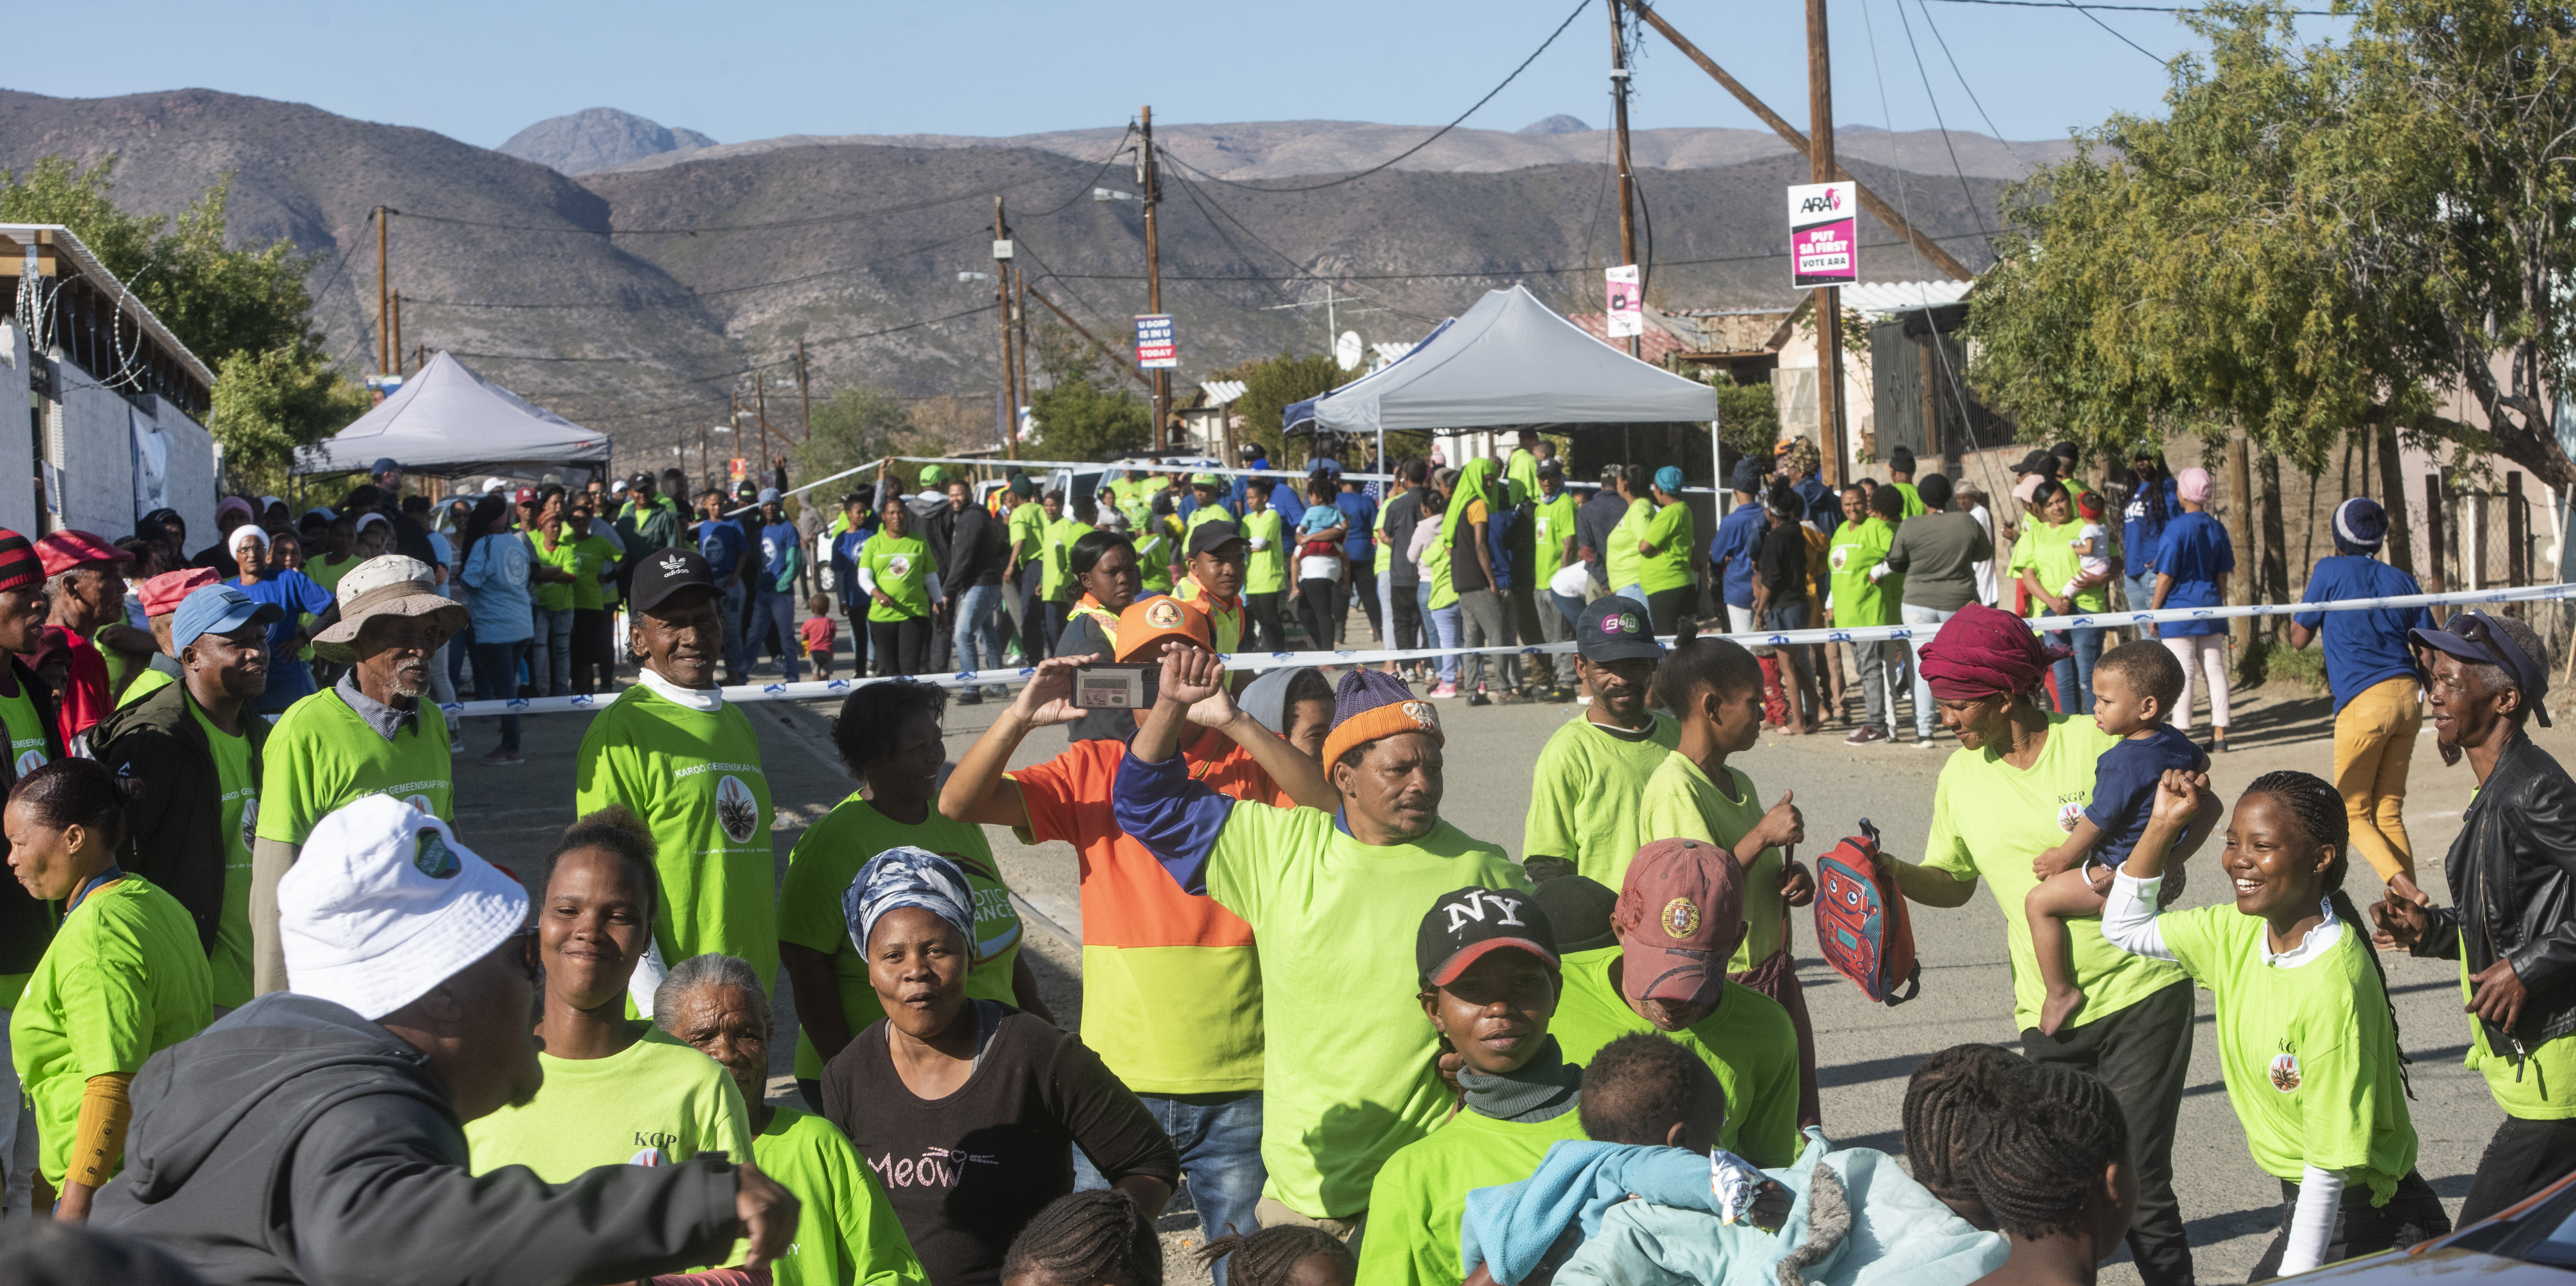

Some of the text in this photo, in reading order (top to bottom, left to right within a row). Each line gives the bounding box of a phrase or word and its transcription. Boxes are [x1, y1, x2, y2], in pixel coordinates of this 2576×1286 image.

[1800, 196, 1833, 214] ARA
[1810, 230, 1835, 243] PUT
[1799, 240, 1848, 255] SA FIRST
[1802, 257, 1846, 268] VOTE ARA
[1140, 348, 1172, 358] TODAY
[664, 568, 689, 578] adidas
[674, 765, 706, 778] KAROO
[707, 763, 751, 772] GEMEENSKAP
[389, 780, 436, 795] GEMEENSKAP
[2058, 791, 2085, 804] KGP
[1443, 889, 1526, 933] NY
[633, 1131, 677, 1149] KGP
[867, 1152, 965, 1189] Meow
